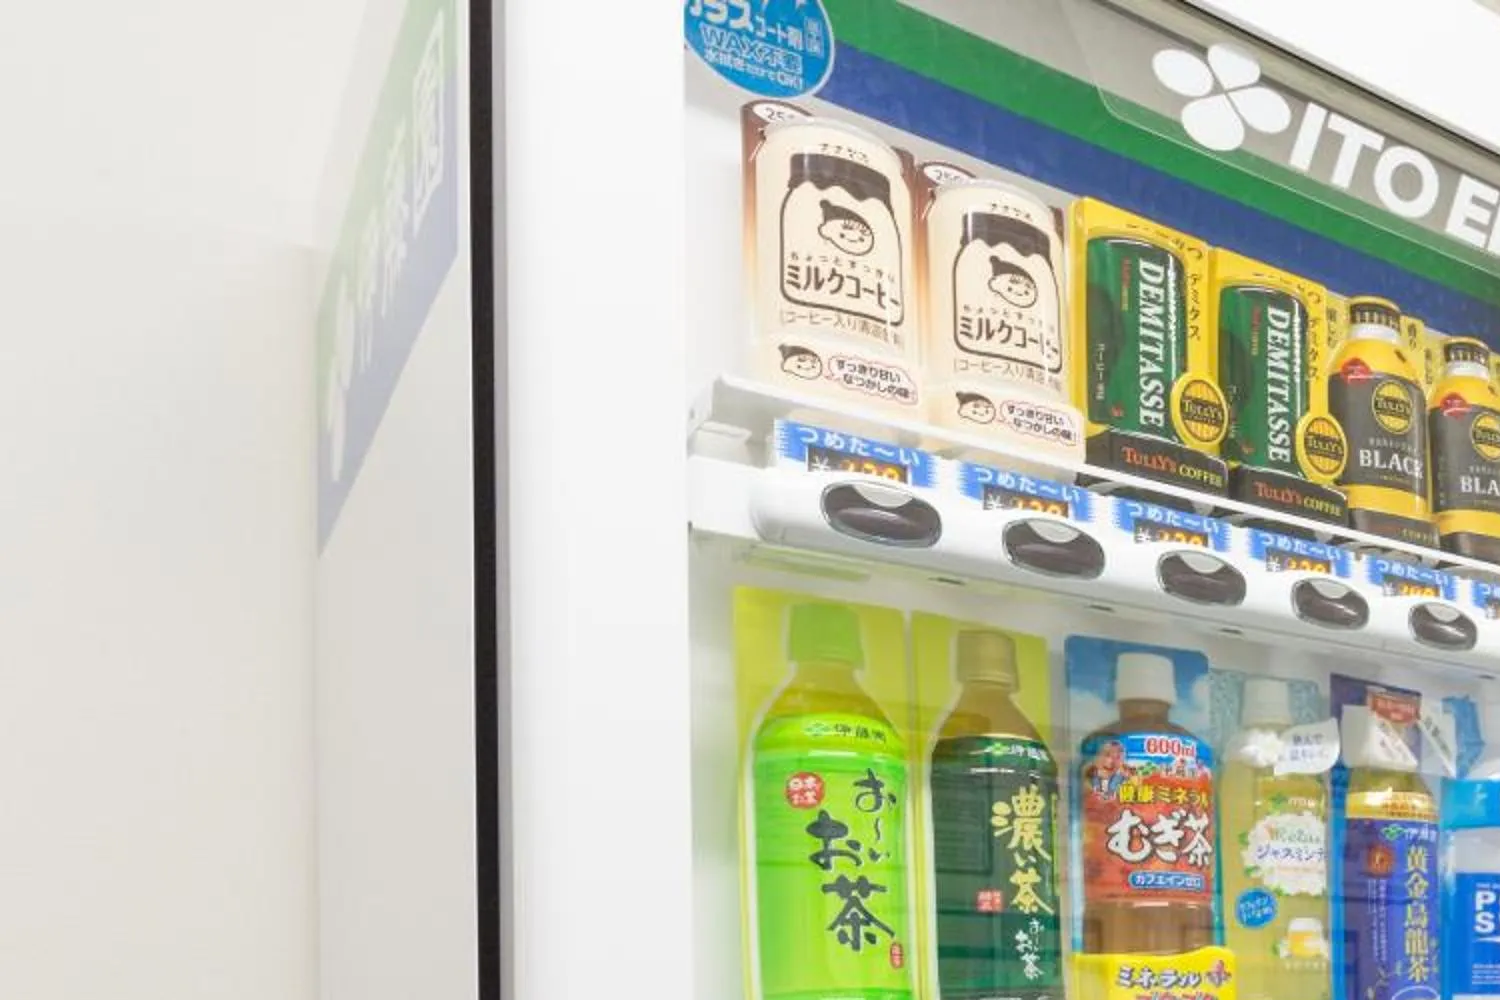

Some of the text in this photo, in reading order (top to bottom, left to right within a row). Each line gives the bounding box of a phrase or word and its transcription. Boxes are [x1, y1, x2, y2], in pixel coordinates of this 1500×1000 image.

[1288, 102, 1440, 219] ITO
[786, 263, 902, 310] ミルクコーヒー
[959, 316, 1060, 359] ミルクコーヒー
[1138, 257, 1166, 429] DEMITASSE
[1266, 304, 1292, 464] DEMITASSE
[1122, 446, 1224, 489] TULLY'S COFFEE
[1359, 449, 1424, 480] BLACK
[1253, 480, 1304, 504] TULLY'S
[1144, 737, 1197, 758] 600ml
[989, 783, 1055, 915] 濃い茶
[1106, 809, 1214, 868] むぎ茶
[805, 810, 896, 953] お茶
